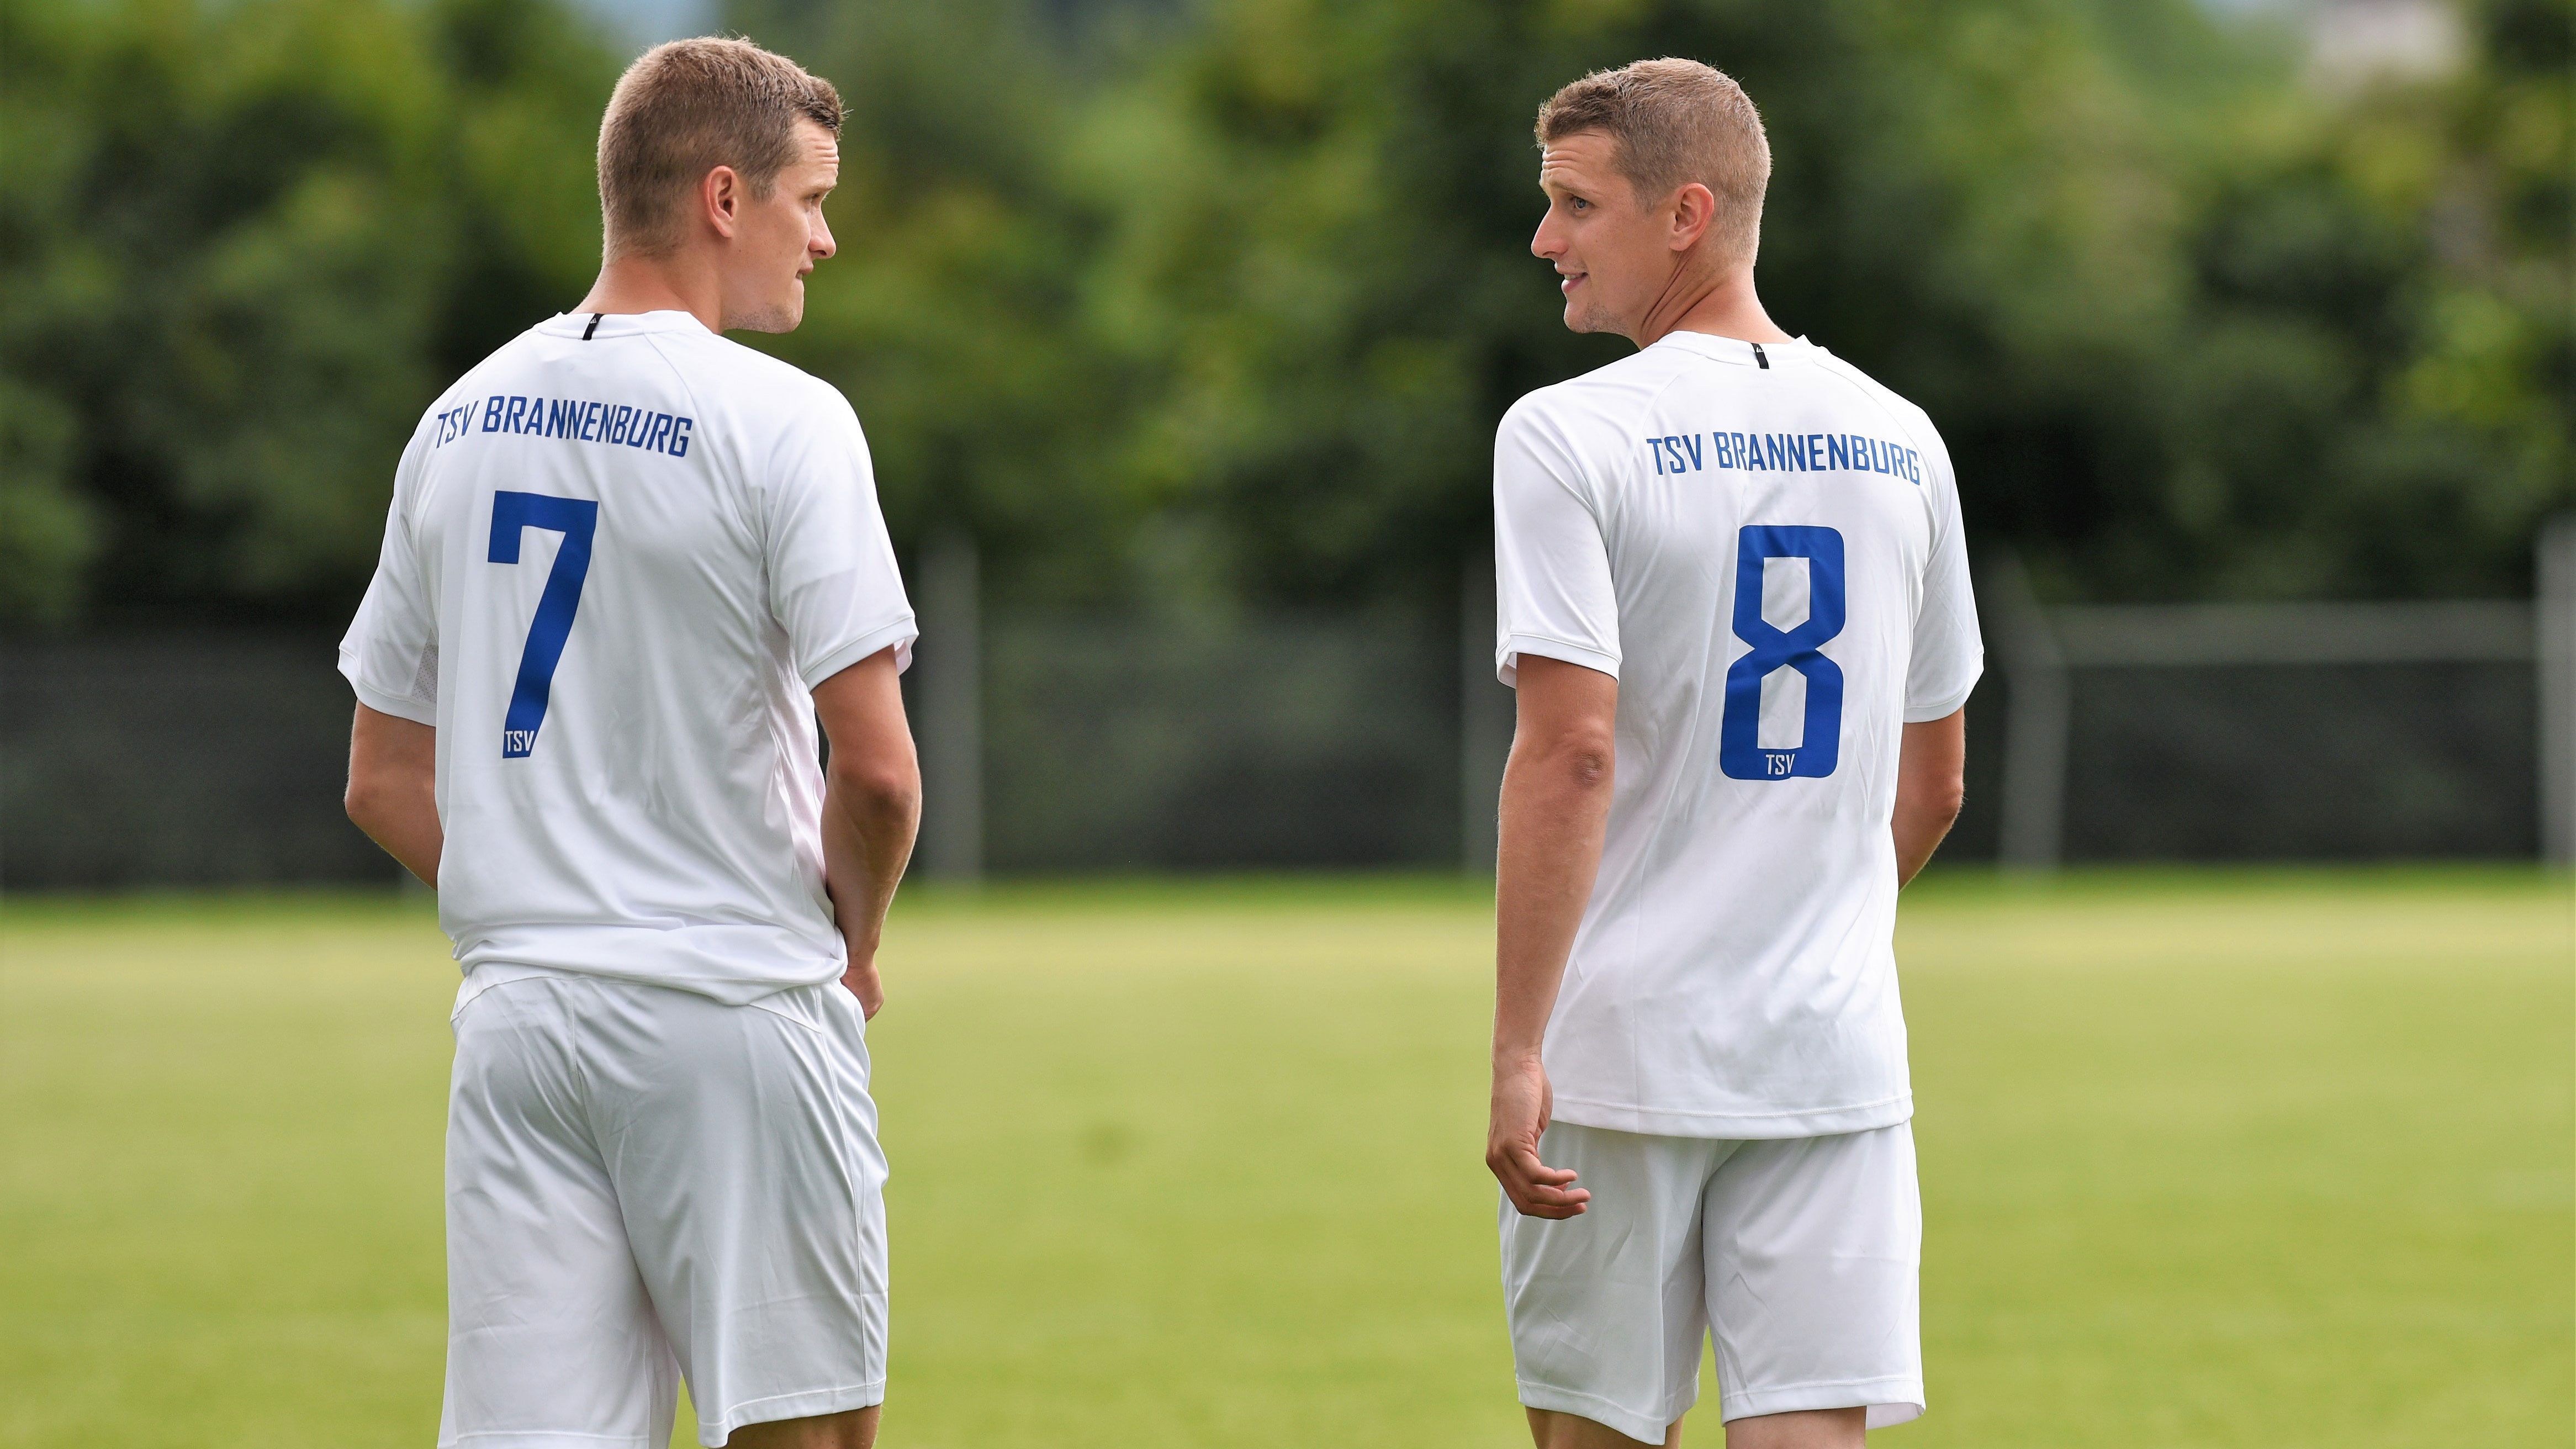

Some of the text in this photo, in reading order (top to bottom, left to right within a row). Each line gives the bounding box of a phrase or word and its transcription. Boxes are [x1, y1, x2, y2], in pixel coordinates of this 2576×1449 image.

[436, 395, 693, 458] TSV BRANNENBURG
[1646, 431, 1921, 486] TSV BRANNENBURG
[487, 490, 599, 759] 7
[1720, 523, 1847, 782] 8
[505, 730, 535, 752] TSV
[1765, 753, 1795, 775] TSV
